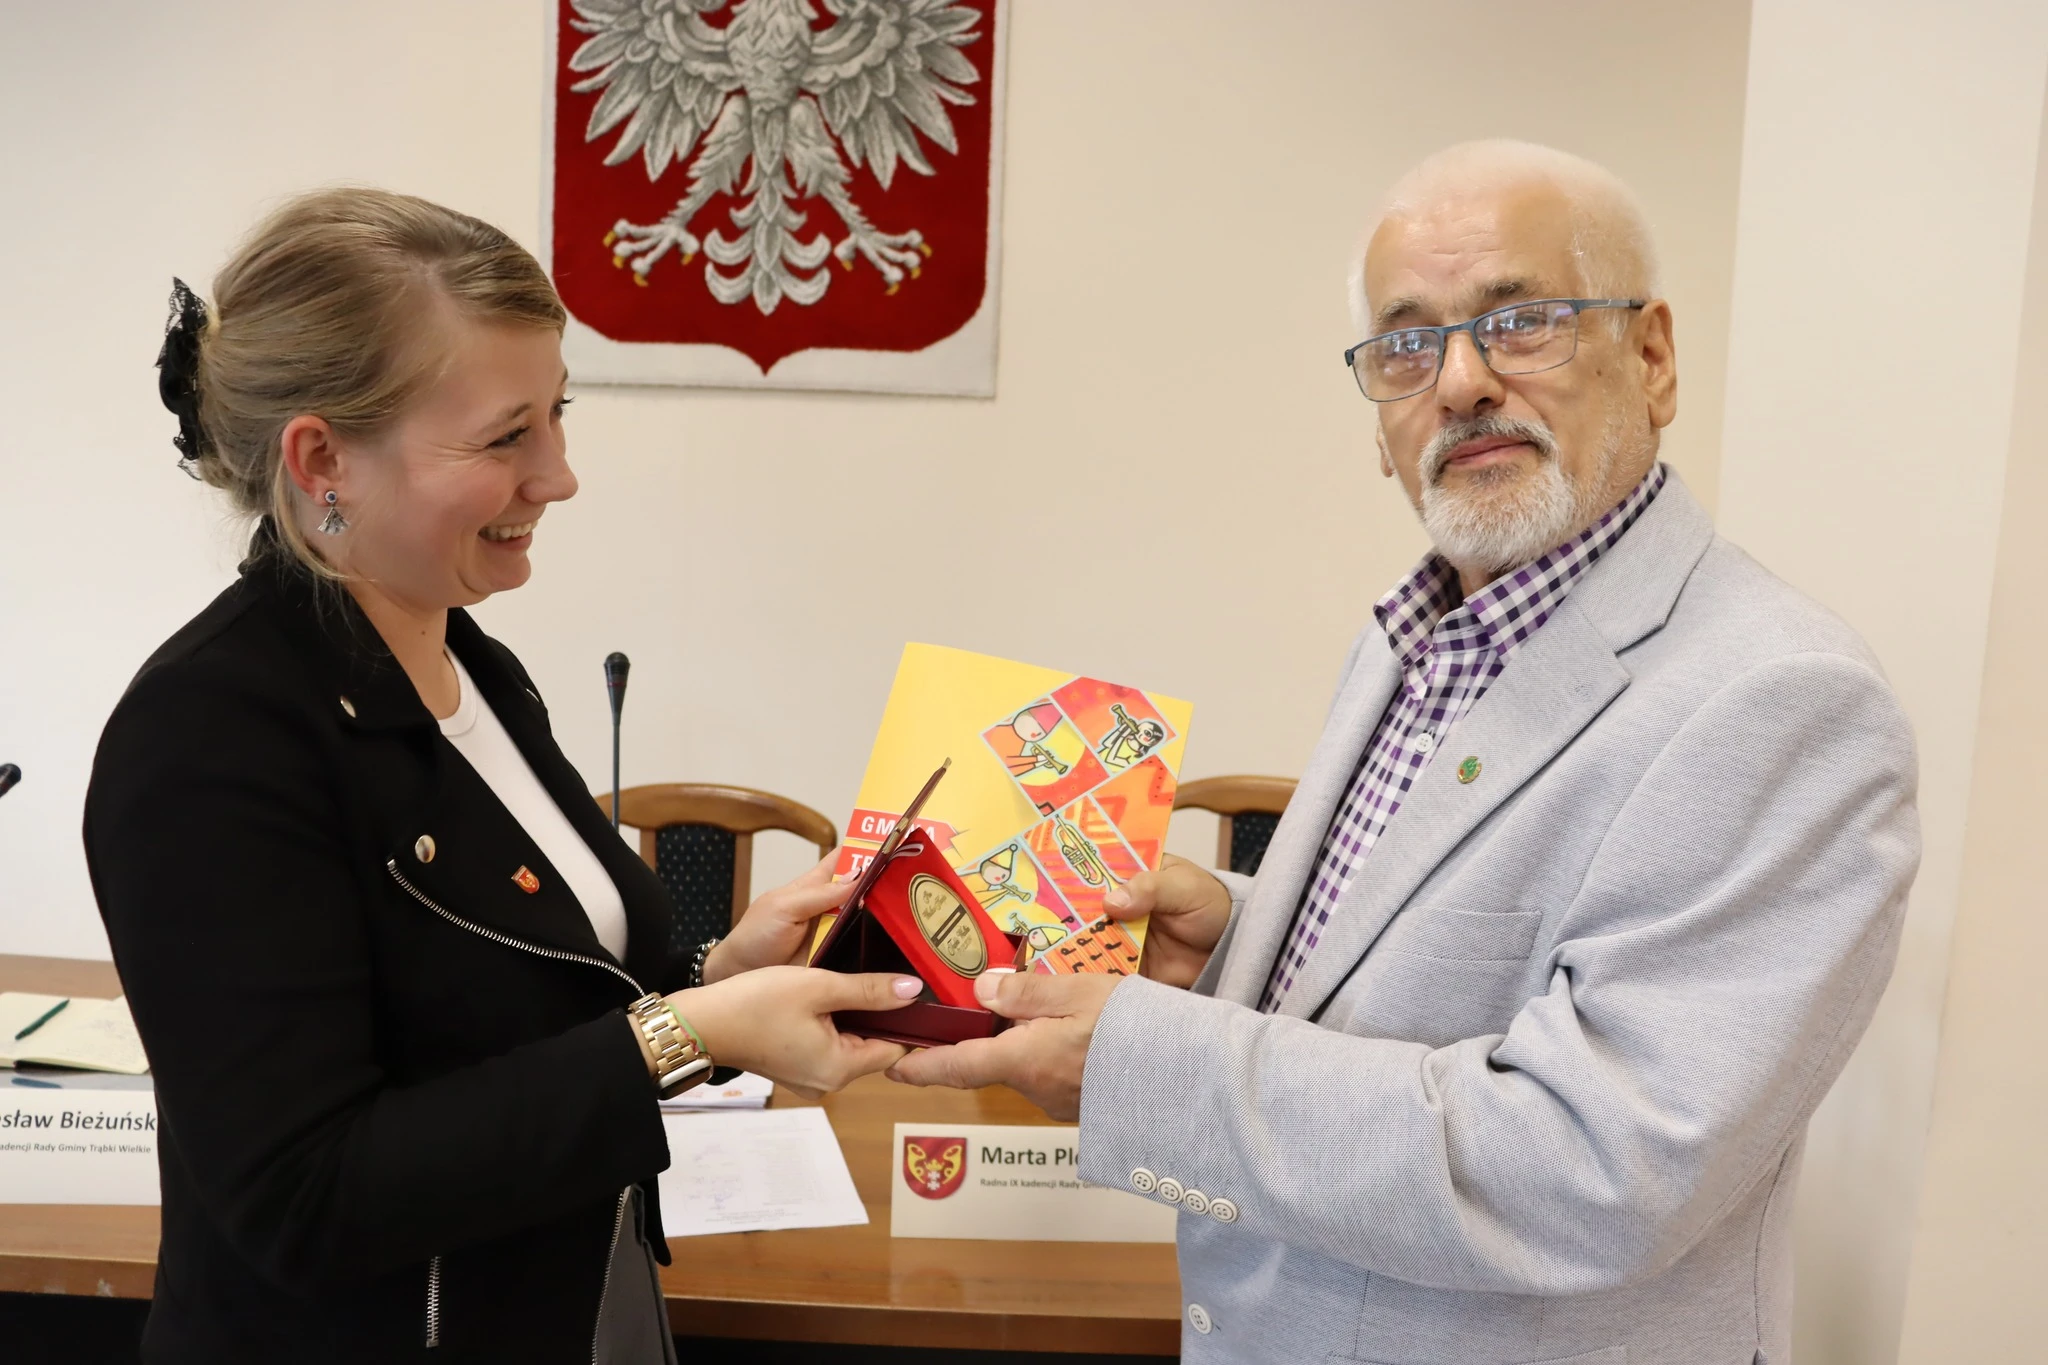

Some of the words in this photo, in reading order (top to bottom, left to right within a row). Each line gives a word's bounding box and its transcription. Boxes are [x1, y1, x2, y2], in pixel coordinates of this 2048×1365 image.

[0, 1109, 54, 1128] sław
[33, 1143, 56, 1153] Rady
[58, 1144, 87, 1153] Gminy
[118, 1144, 152, 1154] Wielkie
[981, 1146, 1047, 1166] Marta
[980, 1179, 1008, 1187] Radna
[1021, 1180, 1057, 1189] kadencji
[1059, 1181, 1080, 1190] Rady
